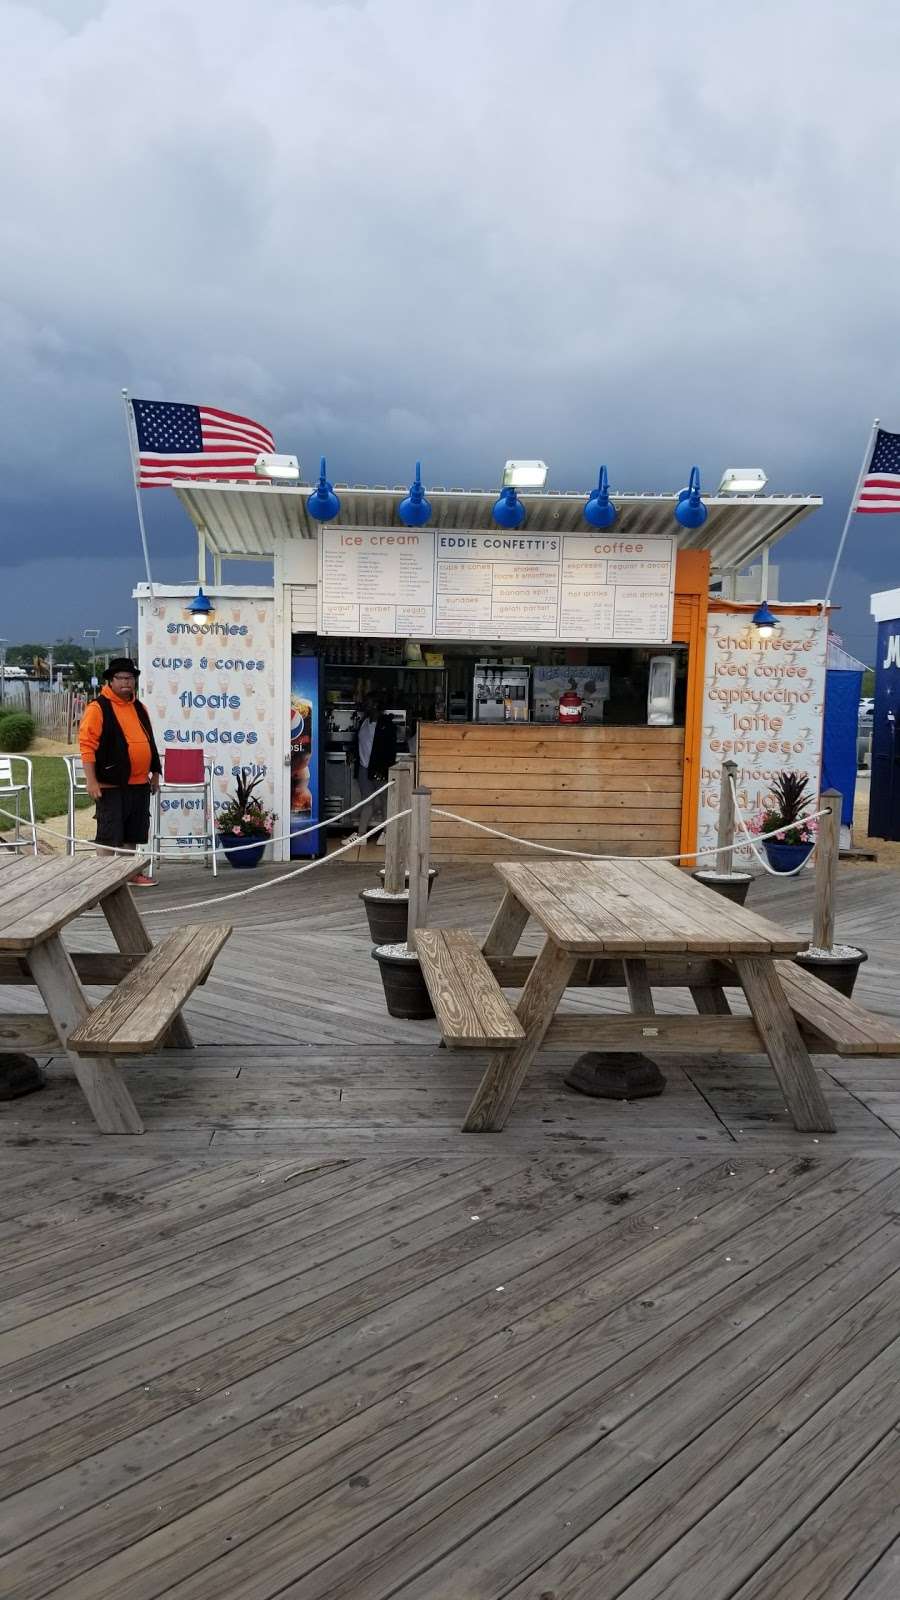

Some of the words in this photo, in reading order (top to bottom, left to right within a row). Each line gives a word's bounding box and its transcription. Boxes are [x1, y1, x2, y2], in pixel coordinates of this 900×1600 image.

[370, 535, 420, 546] cream
[440, 537, 478, 548] EDDIE
[483, 539, 557, 550] CONFETTI'S
[594, 542, 644, 554] coffee
[167, 622, 249, 636] smoothies
[717, 636, 753, 650] chai
[759, 637, 813, 651] freeze
[152, 656, 193, 671] cups
[214, 658, 266, 671] cones
[714, 662, 749, 677] iced
[754, 663, 808, 678] coffee
[179, 690, 242, 710] floats
[708, 688, 811, 705] cappuccino
[733, 713, 784, 732] latte
[163, 728, 259, 745] sundaes
[709, 740, 805, 755] espresso
[701, 767, 721, 780] ho
[160, 798, 205, 812] gelati
